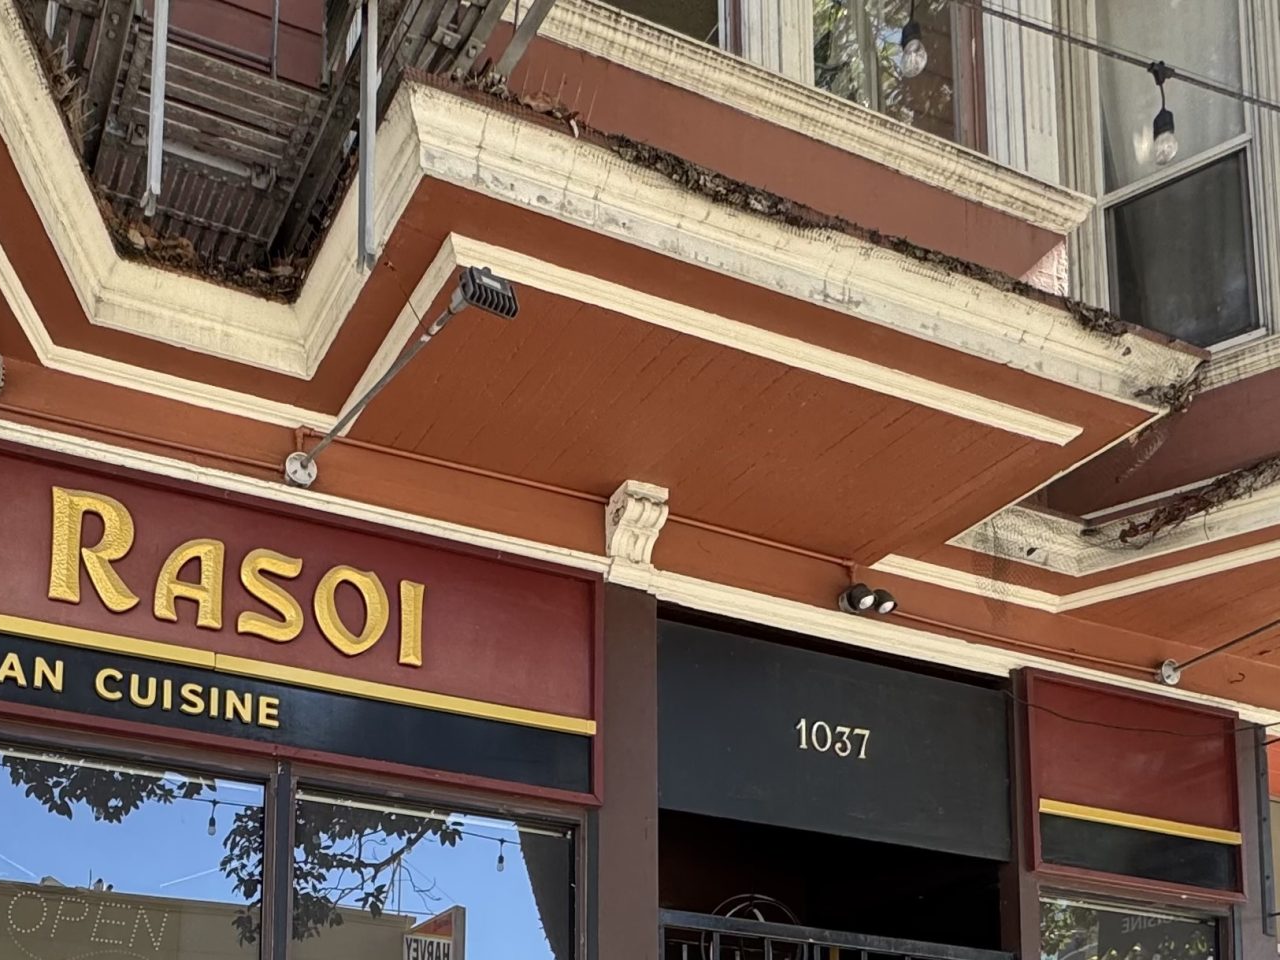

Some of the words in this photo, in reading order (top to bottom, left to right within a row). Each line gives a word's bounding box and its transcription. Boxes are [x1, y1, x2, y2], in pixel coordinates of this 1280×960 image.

[47, 485, 426, 668] RASOI
[95, 667, 282, 729] CUISINE
[795, 717, 871, 759] 1037
[7, 890, 169, 951] OPEN
